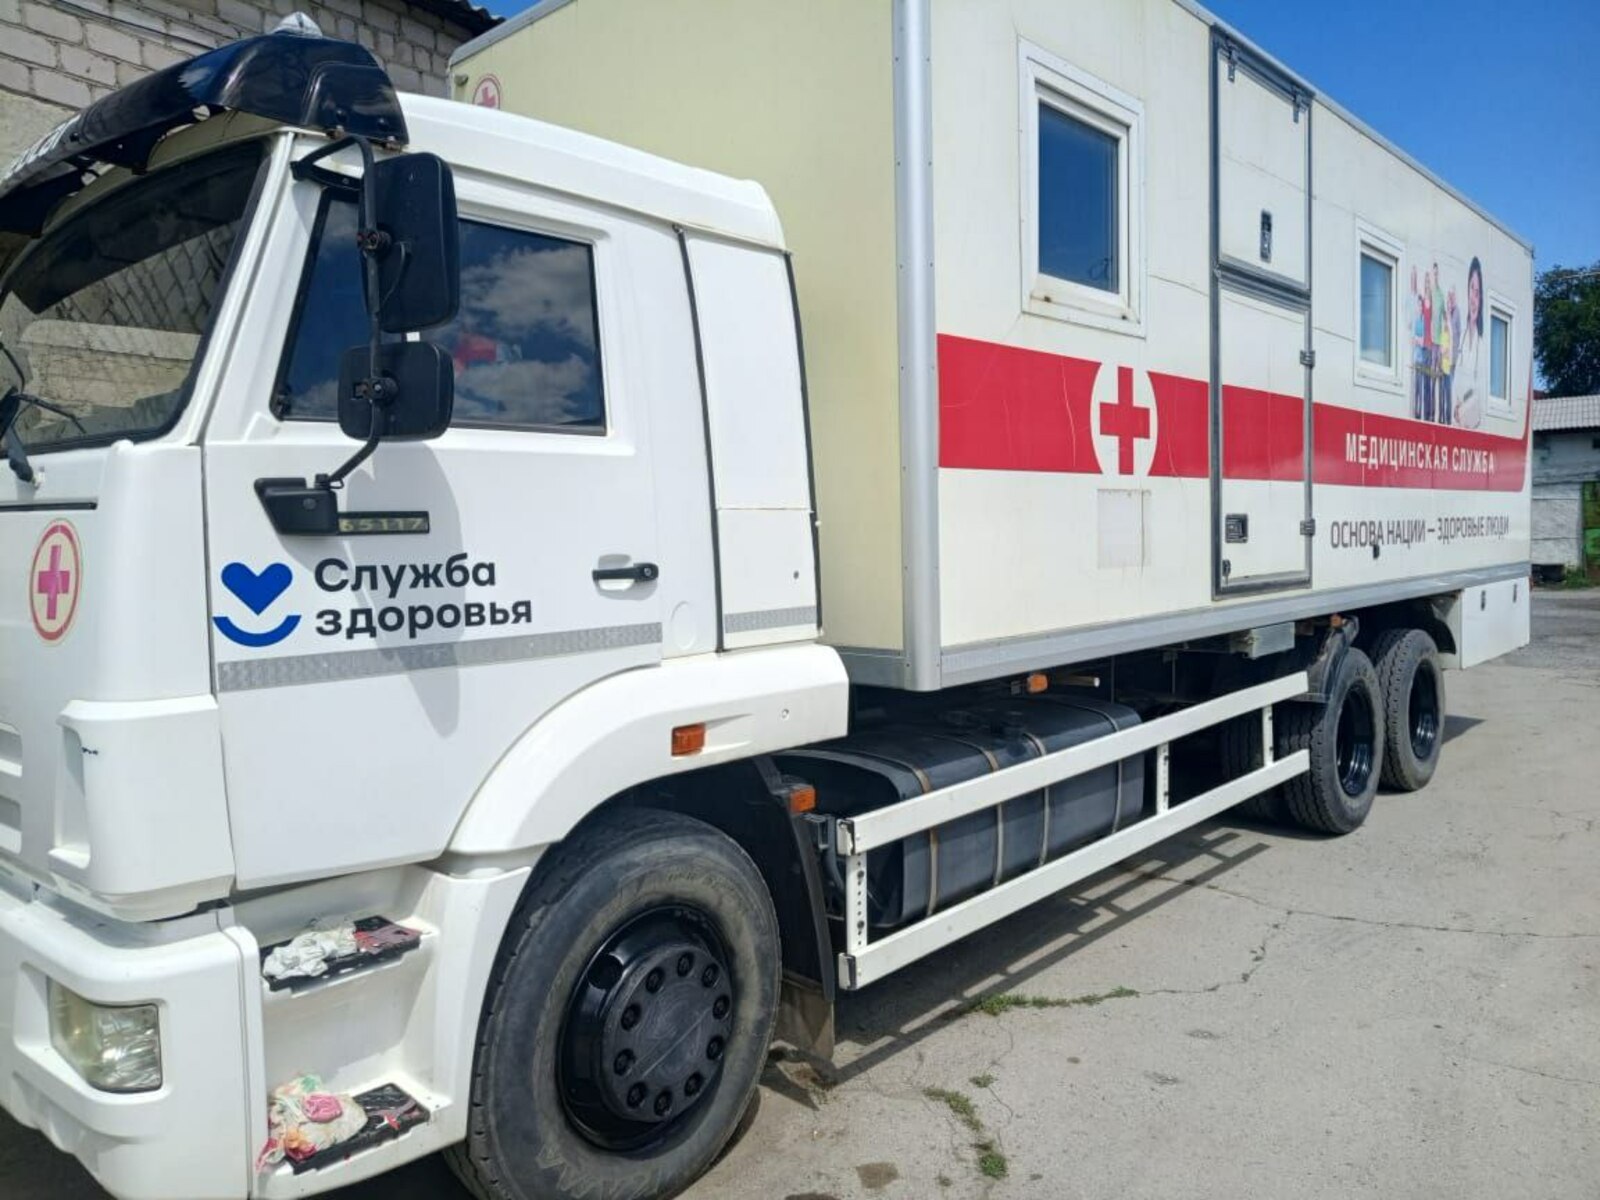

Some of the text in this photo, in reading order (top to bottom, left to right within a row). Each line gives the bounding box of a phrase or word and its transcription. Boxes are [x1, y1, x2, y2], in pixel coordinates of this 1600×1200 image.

[1345, 432, 1495, 473] МЕДИЦИНСКАЯ СЛУЖБА
[339, 518, 425, 532] 65117
[1331, 520, 1385, 549] ОСНОВА
[1387, 520, 1426, 549] НАЦИИ
[1437, 516, 1485, 544] ЗДОРОВЫЕ
[314, 553, 496, 599] Служба
[315, 600, 533, 639] здоровья
